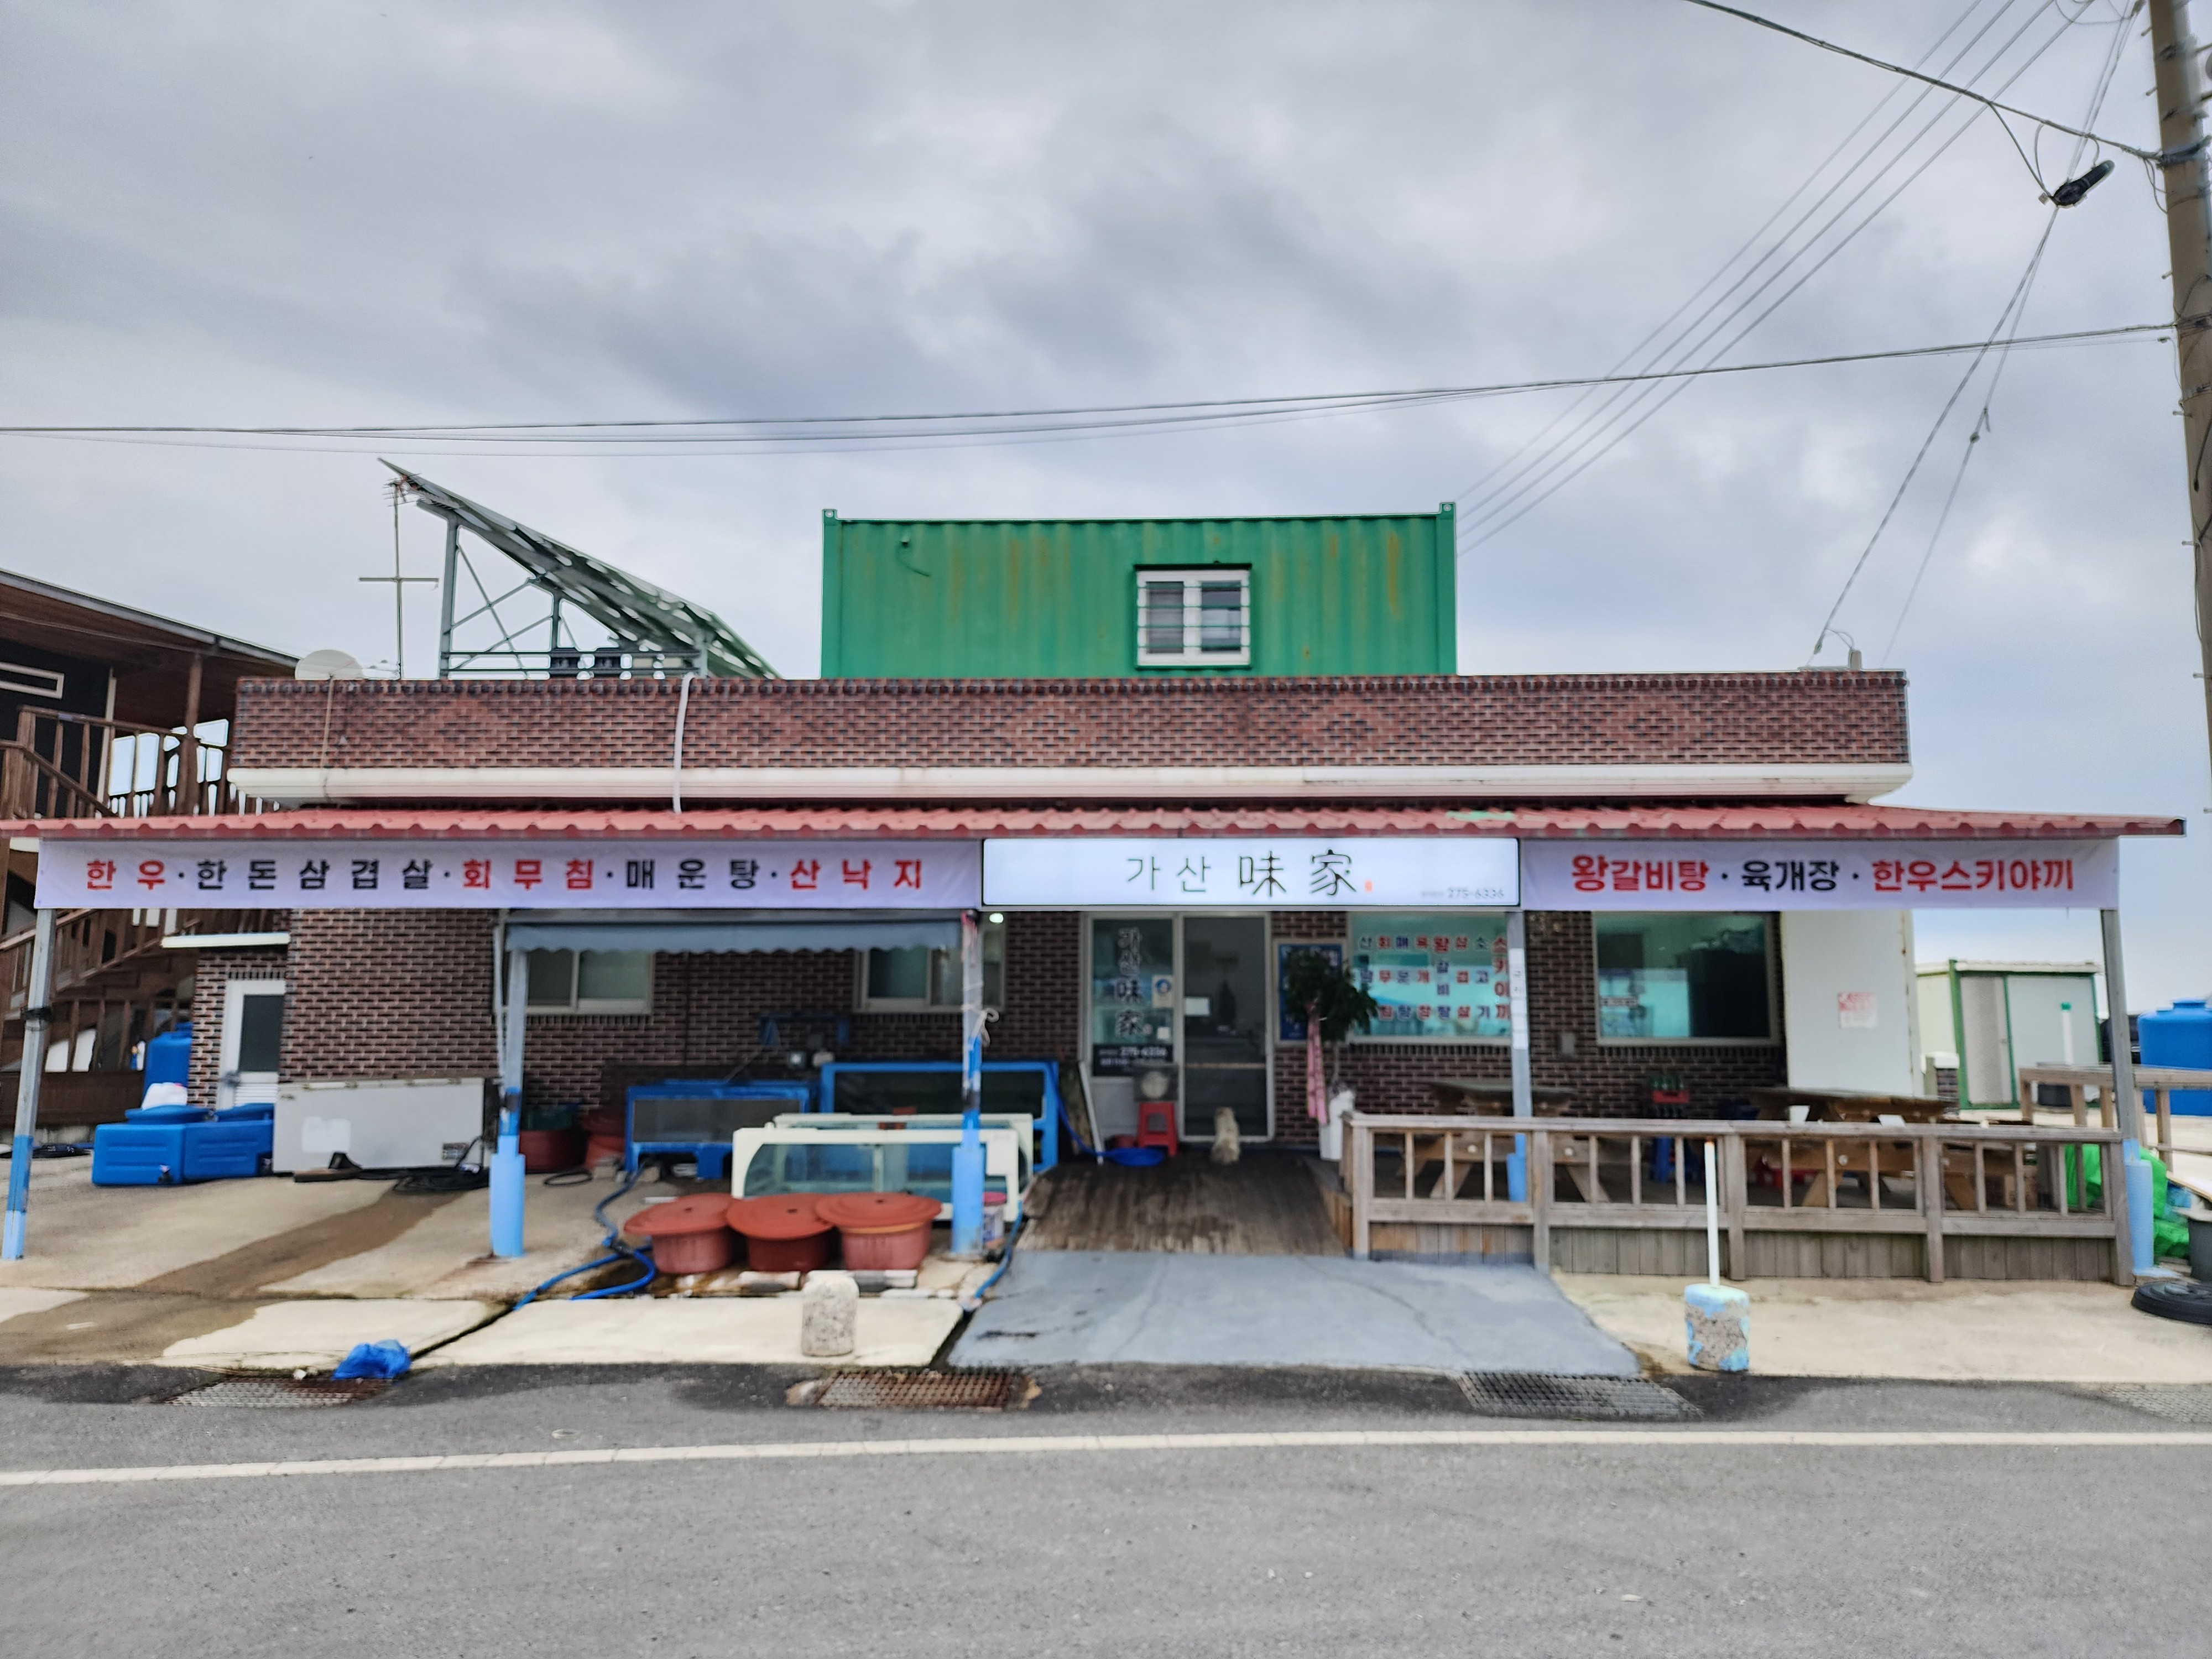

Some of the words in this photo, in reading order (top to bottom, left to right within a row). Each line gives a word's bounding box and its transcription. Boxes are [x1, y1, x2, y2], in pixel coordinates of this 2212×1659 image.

[1571, 853, 1709, 892] 왕갈비탕
[1740, 859, 1840, 892] 육개장
[1871, 858, 2075, 892] 한우스키야끼
